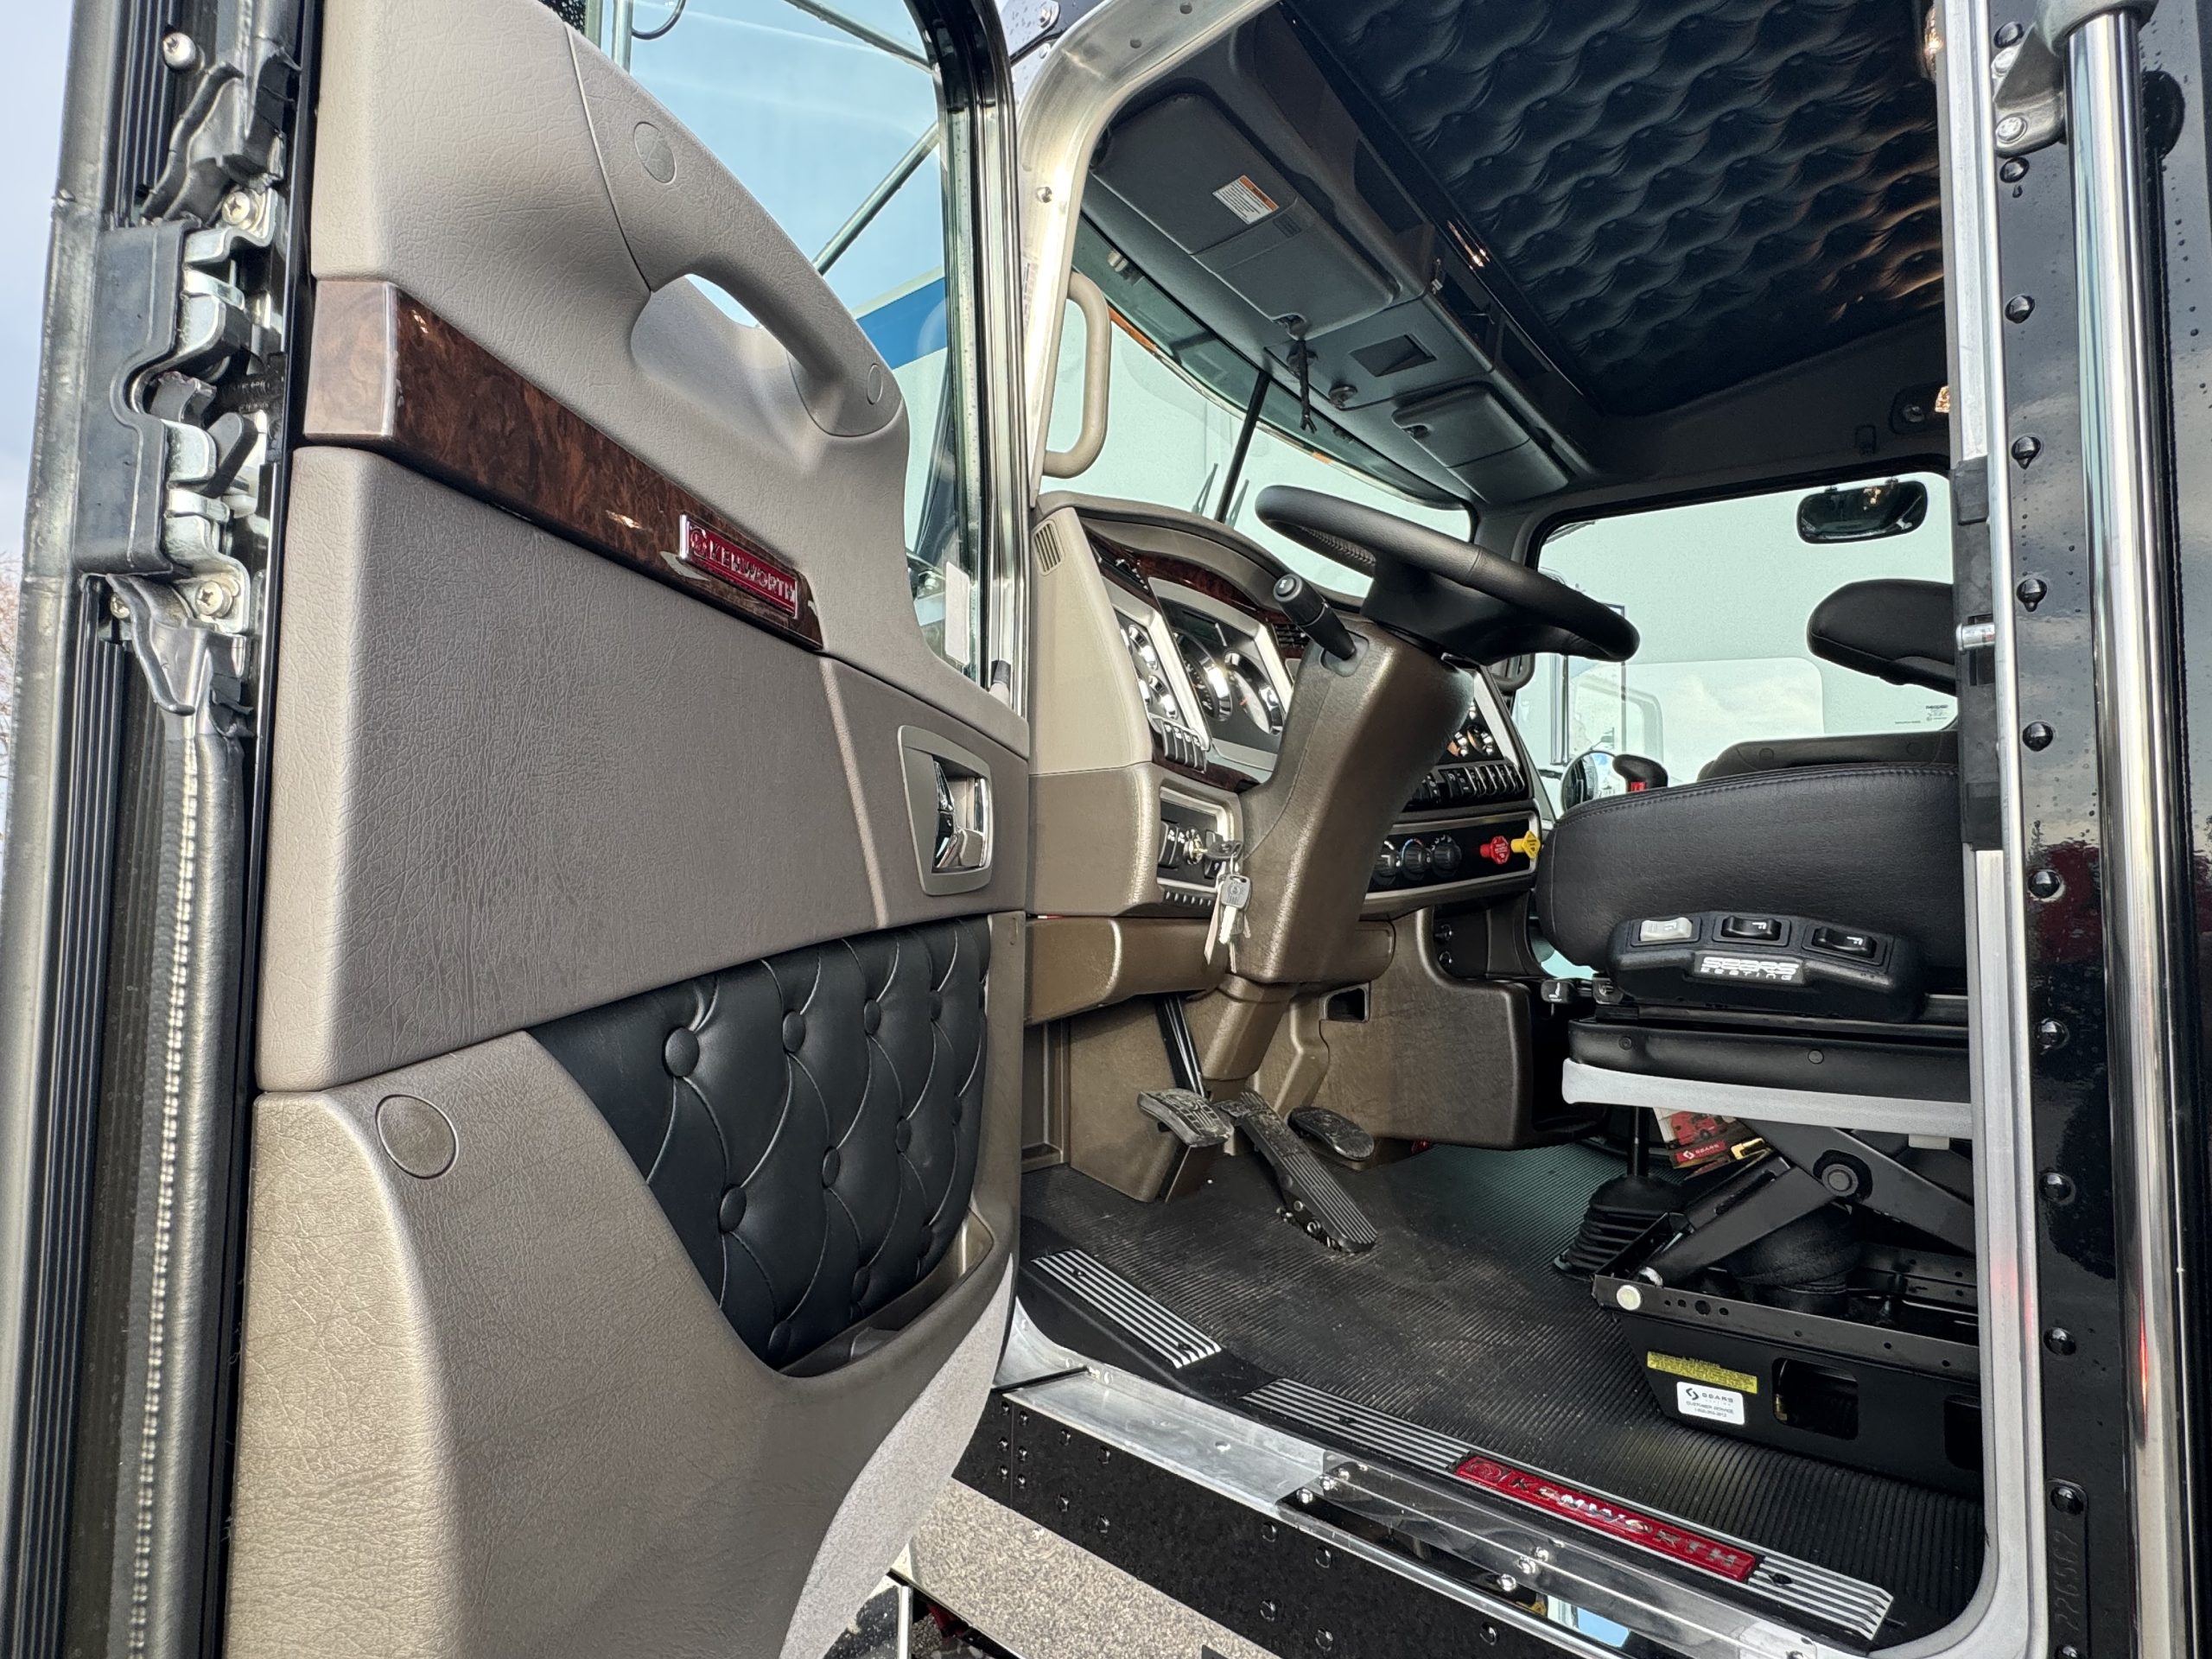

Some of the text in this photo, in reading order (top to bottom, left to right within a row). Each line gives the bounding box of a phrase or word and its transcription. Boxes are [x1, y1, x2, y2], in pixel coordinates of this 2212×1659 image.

[709, 539, 796, 604] KENWORTH
[1701, 1392, 1734, 1403] SEARS
[1509, 1477, 1738, 1566] KENWORTH
